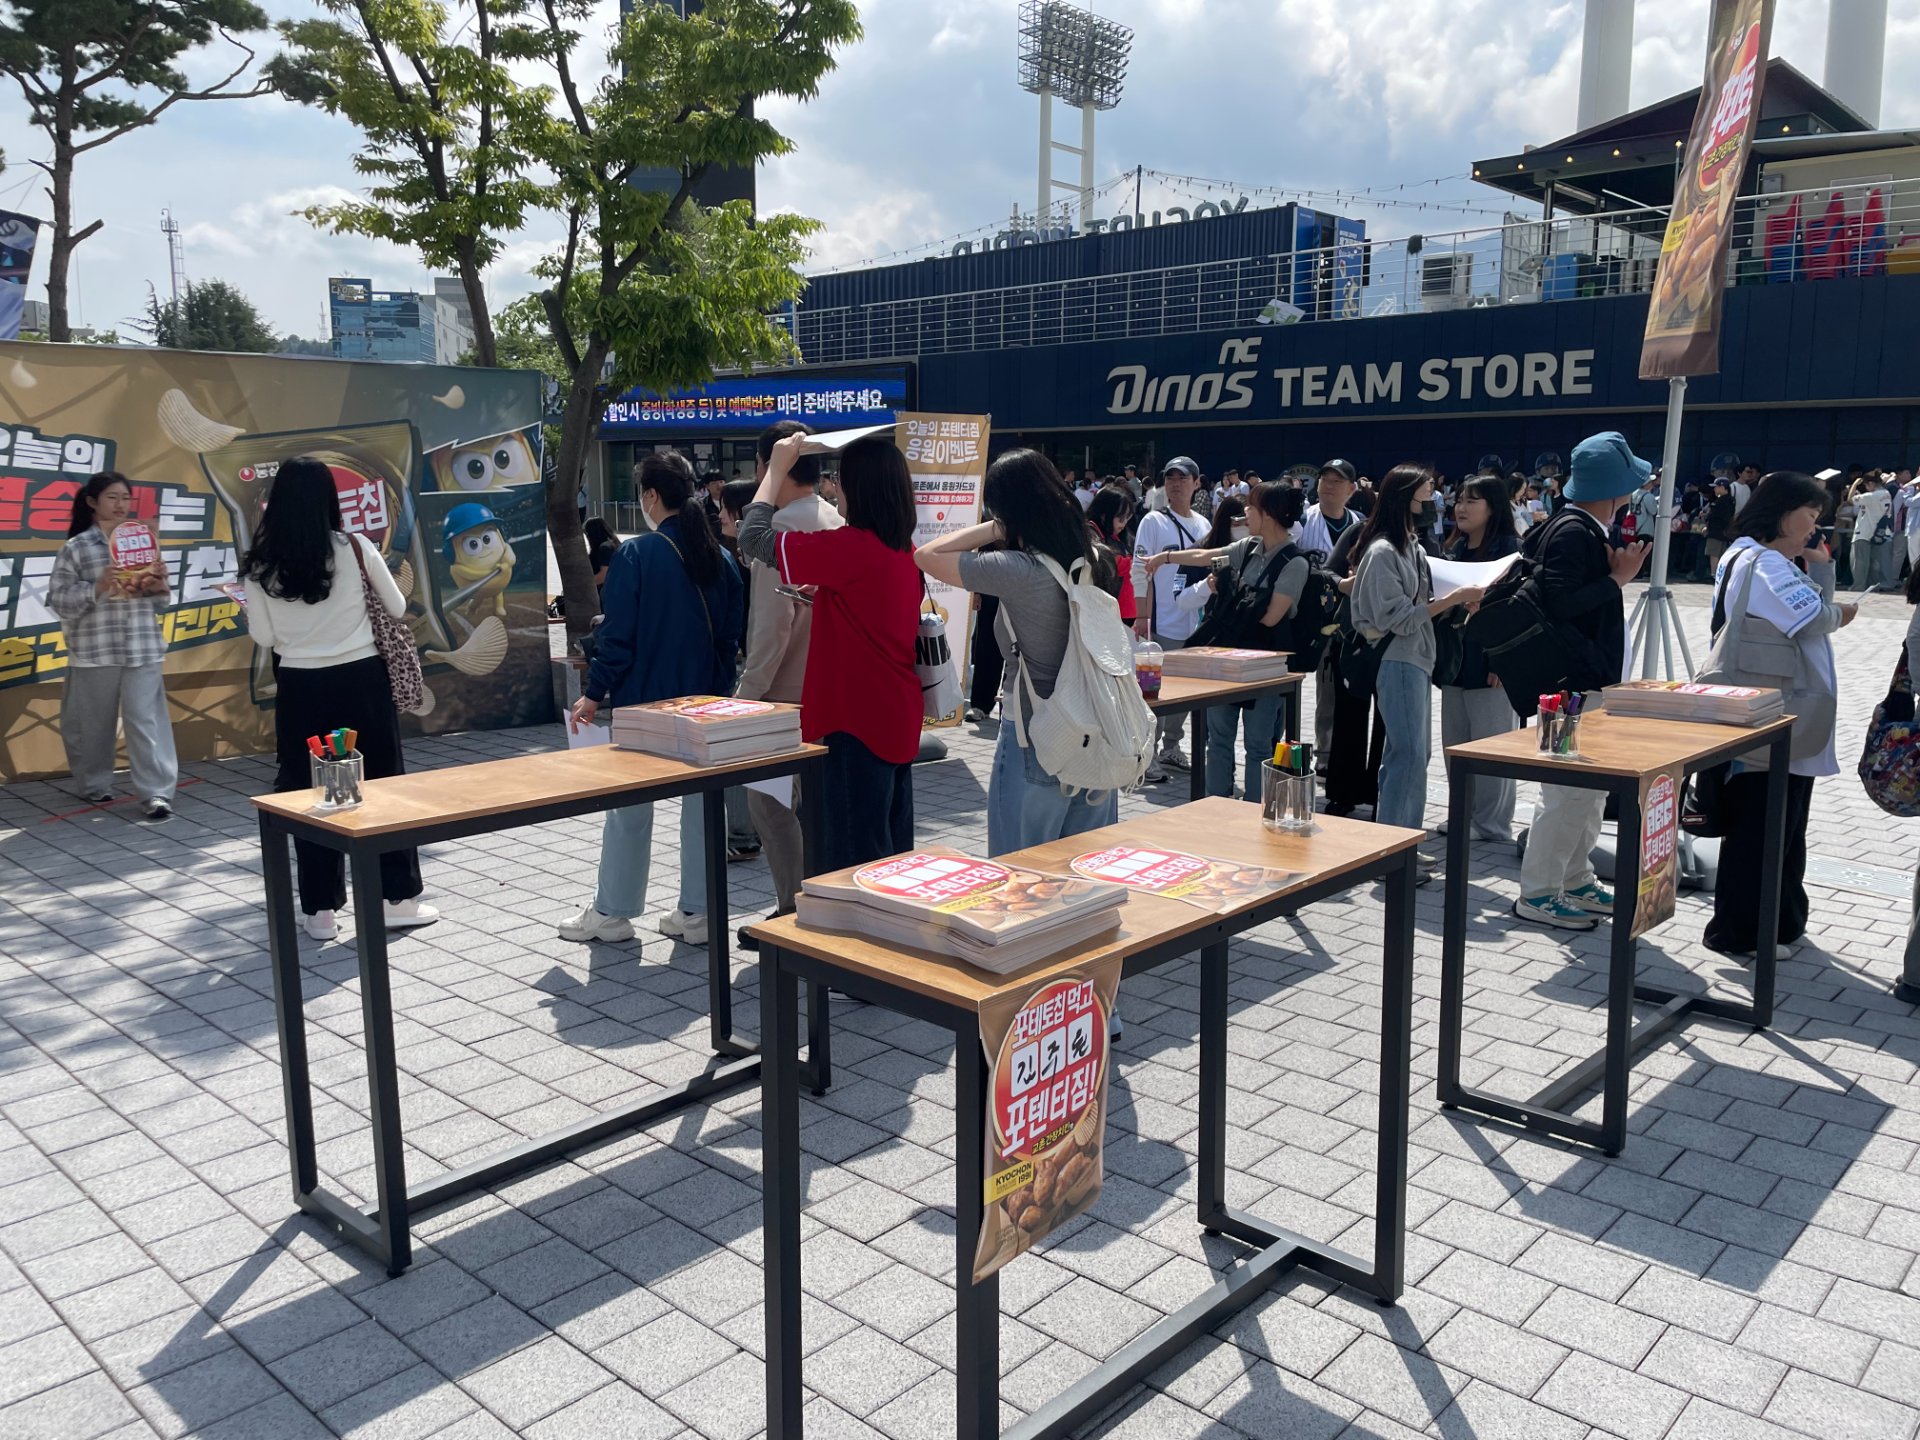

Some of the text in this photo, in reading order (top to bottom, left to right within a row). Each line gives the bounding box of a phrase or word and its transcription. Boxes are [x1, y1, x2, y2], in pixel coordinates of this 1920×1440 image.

[1273, 361, 1403, 407] TEAM
[1416, 348, 1596, 402] STORE
[715, 397, 727, 418] 및
[728, 394, 776, 417] 예매번호
[777, 391, 802, 415] 미리
[803, 388, 888, 414] 준비해주세요.
[906, 420, 980, 438] 오늘의 포텐터짐
[0, 427, 106, 474] 늘의
[905, 438, 979, 465] 응원이벤트
[942, 481, 976, 491] 응원카드와
[337, 479, 389, 533] 토칩
[905, 865, 1010, 903] 포텐터짐!
[1012, 979, 1094, 1050] 포테토칩 먹고
[1002, 1059, 1098, 1157] 포텐터짐!
[995, 1161, 1032, 1186] KYOCHON
